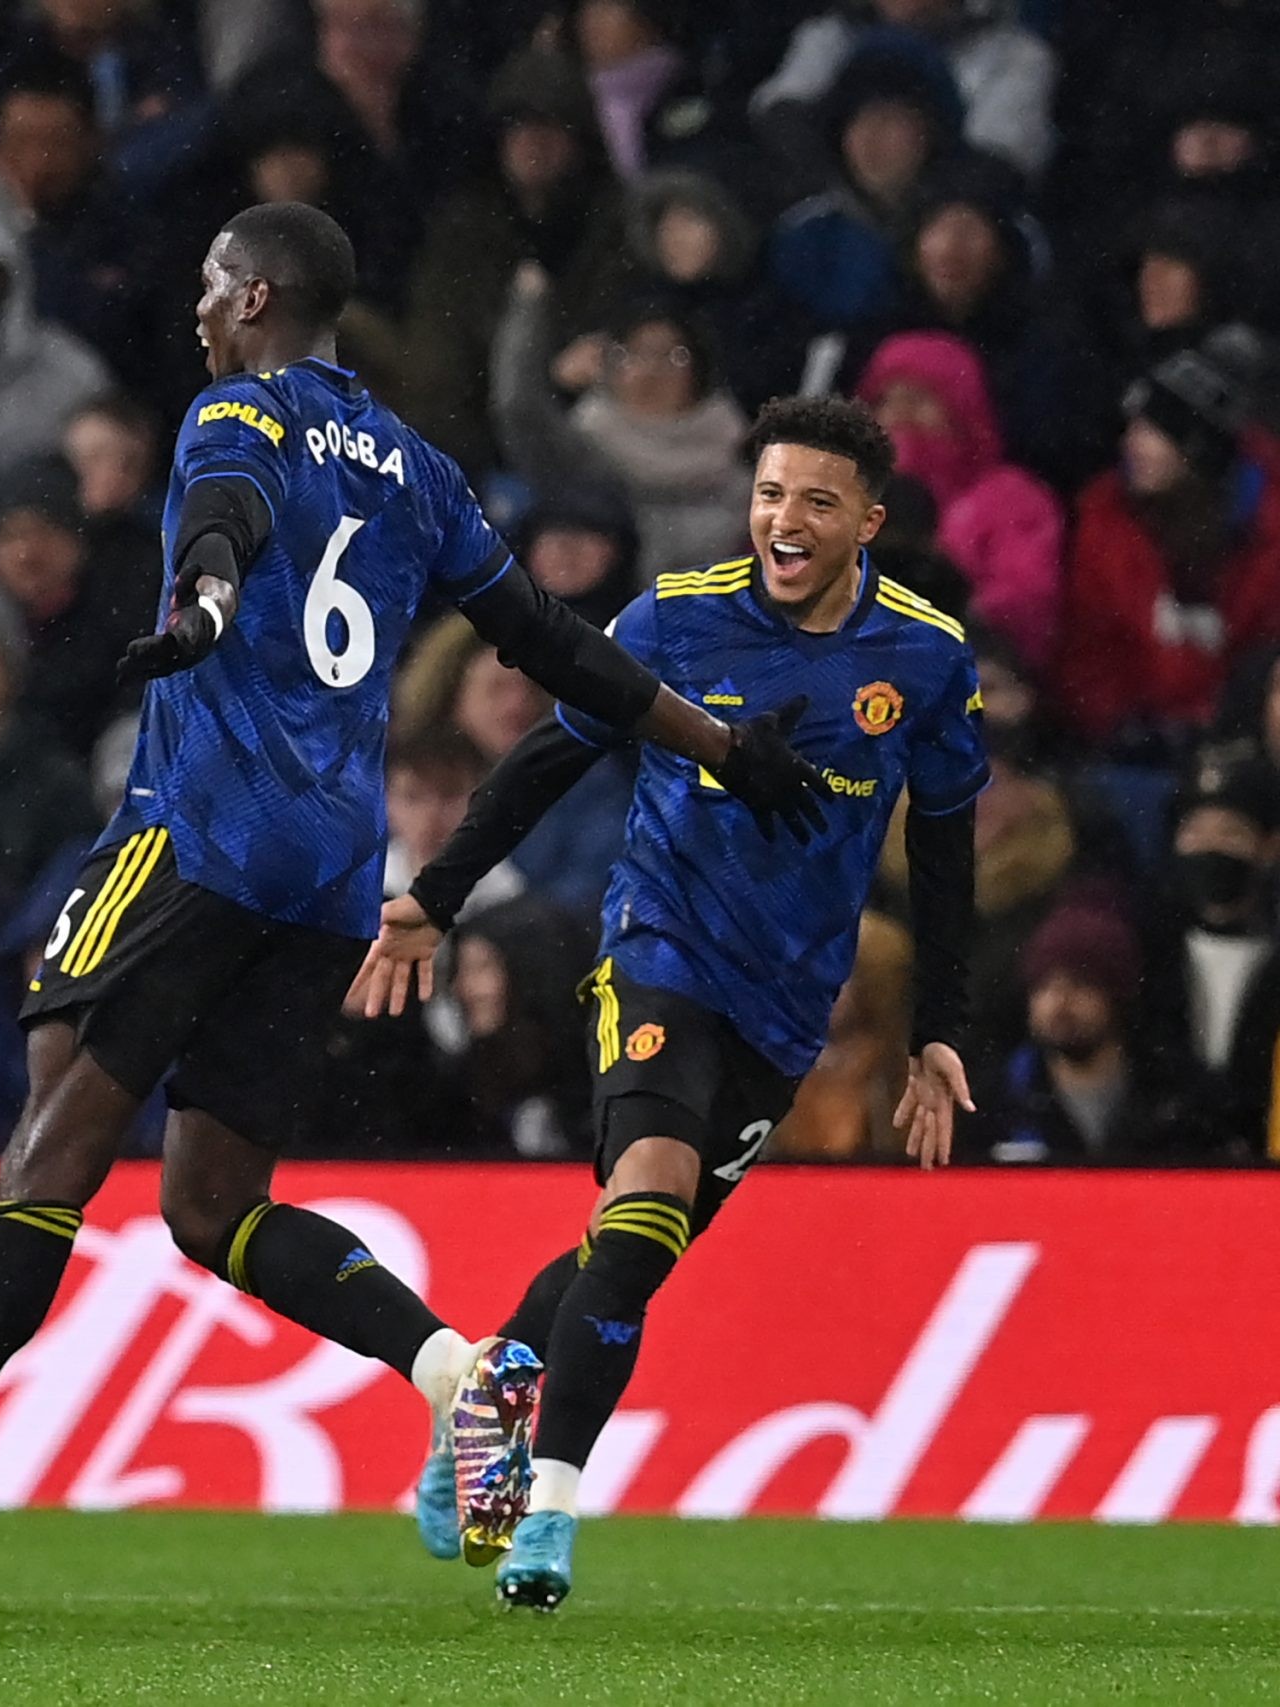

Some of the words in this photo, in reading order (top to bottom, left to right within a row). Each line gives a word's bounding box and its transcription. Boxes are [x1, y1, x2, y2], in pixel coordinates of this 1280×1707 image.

[198, 401, 285, 447] KOHLER
[304, 419, 405, 485] POGBA
[303, 515, 375, 688] 6
[702, 693, 744, 707] adidas
[43, 887, 87, 961] 6
